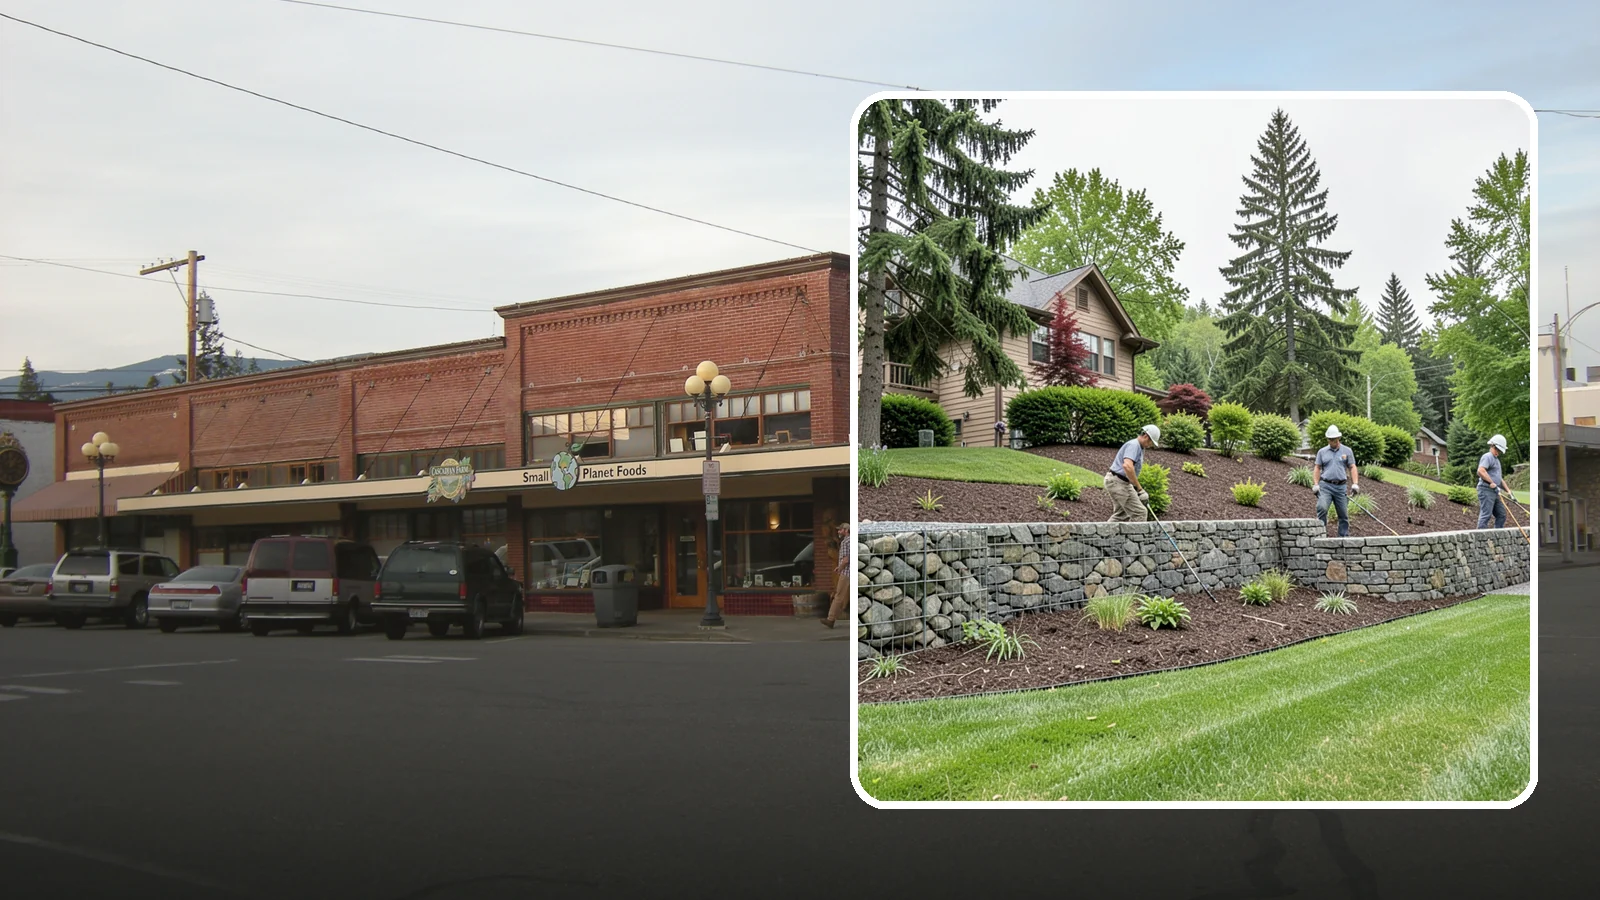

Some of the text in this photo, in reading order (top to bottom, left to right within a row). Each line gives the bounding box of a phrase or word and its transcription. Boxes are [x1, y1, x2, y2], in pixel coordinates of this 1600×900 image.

[523, 464, 647, 483] Small Planet Foods
